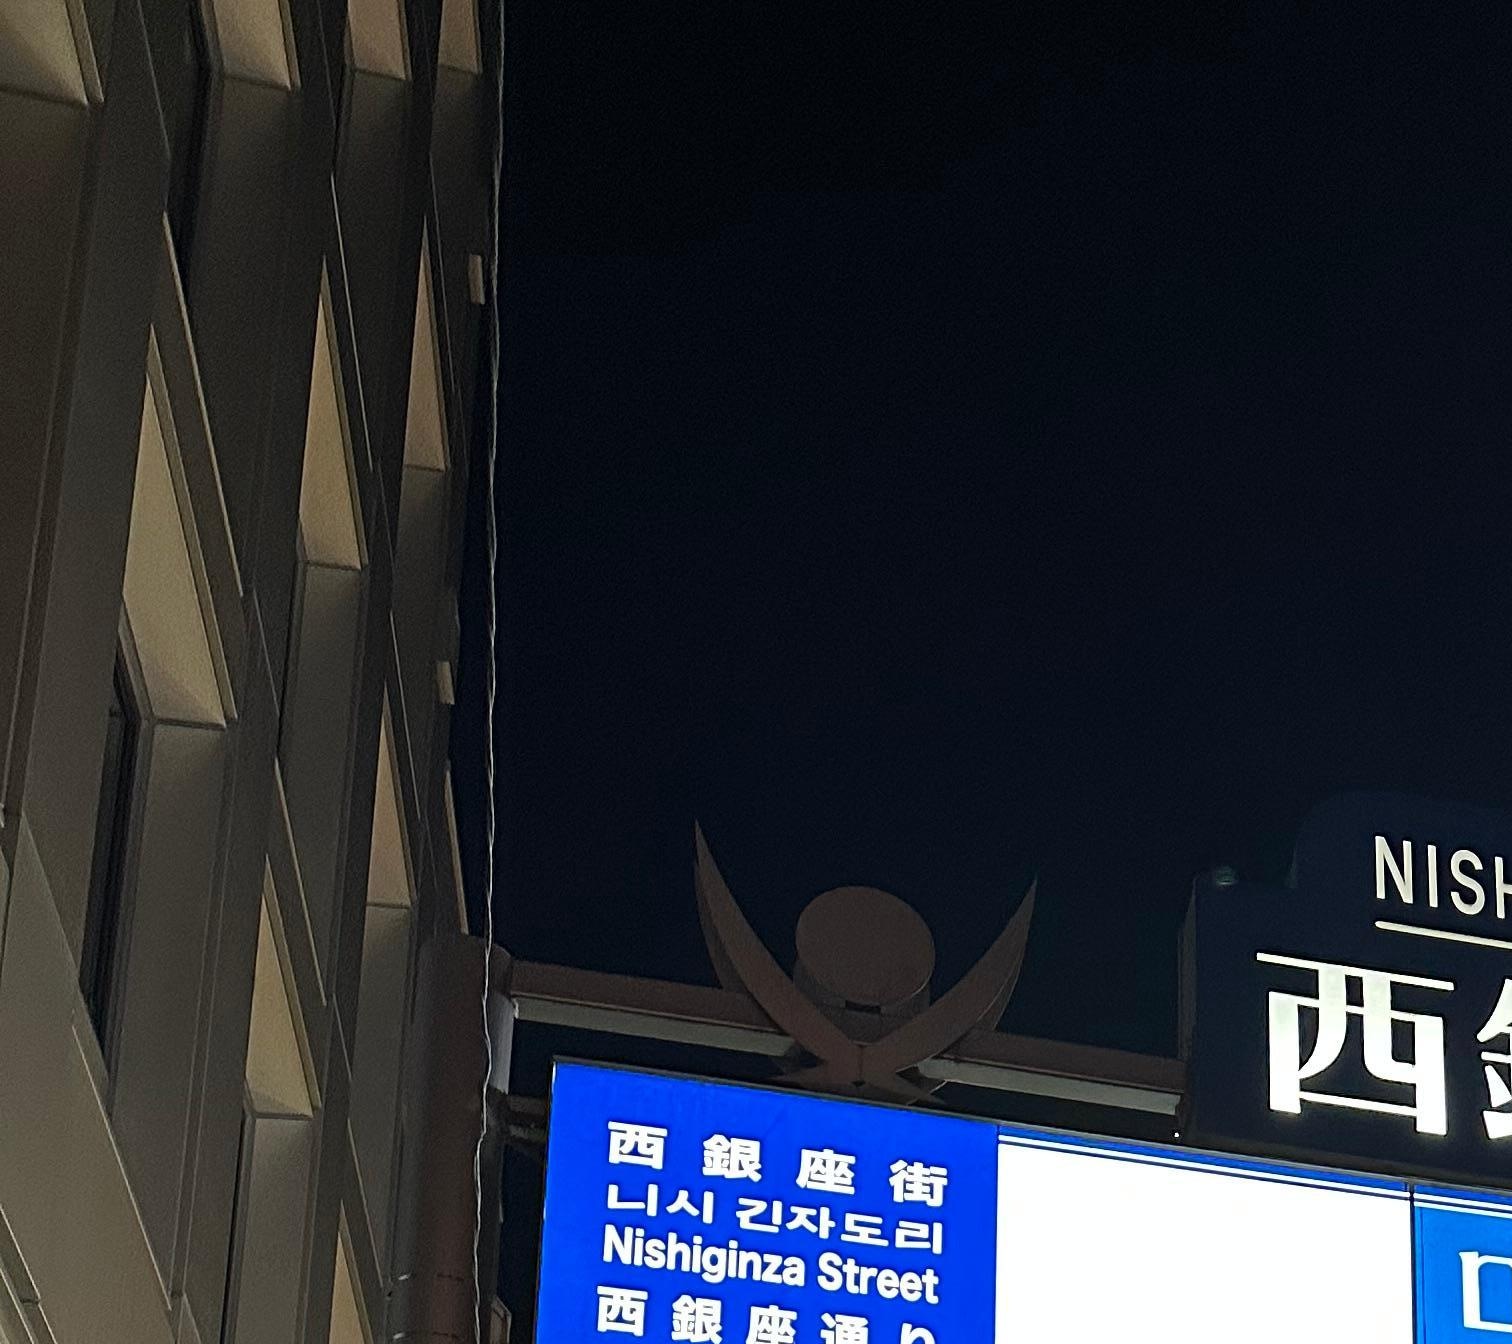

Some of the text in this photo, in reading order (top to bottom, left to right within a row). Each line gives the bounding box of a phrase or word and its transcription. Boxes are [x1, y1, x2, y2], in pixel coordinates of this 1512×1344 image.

[607, 1119, 949, 1208] 西銀座街
[605, 1183, 944, 1258] 니시 긴자도리
[603, 1223, 941, 1307] Nishiginza Street
